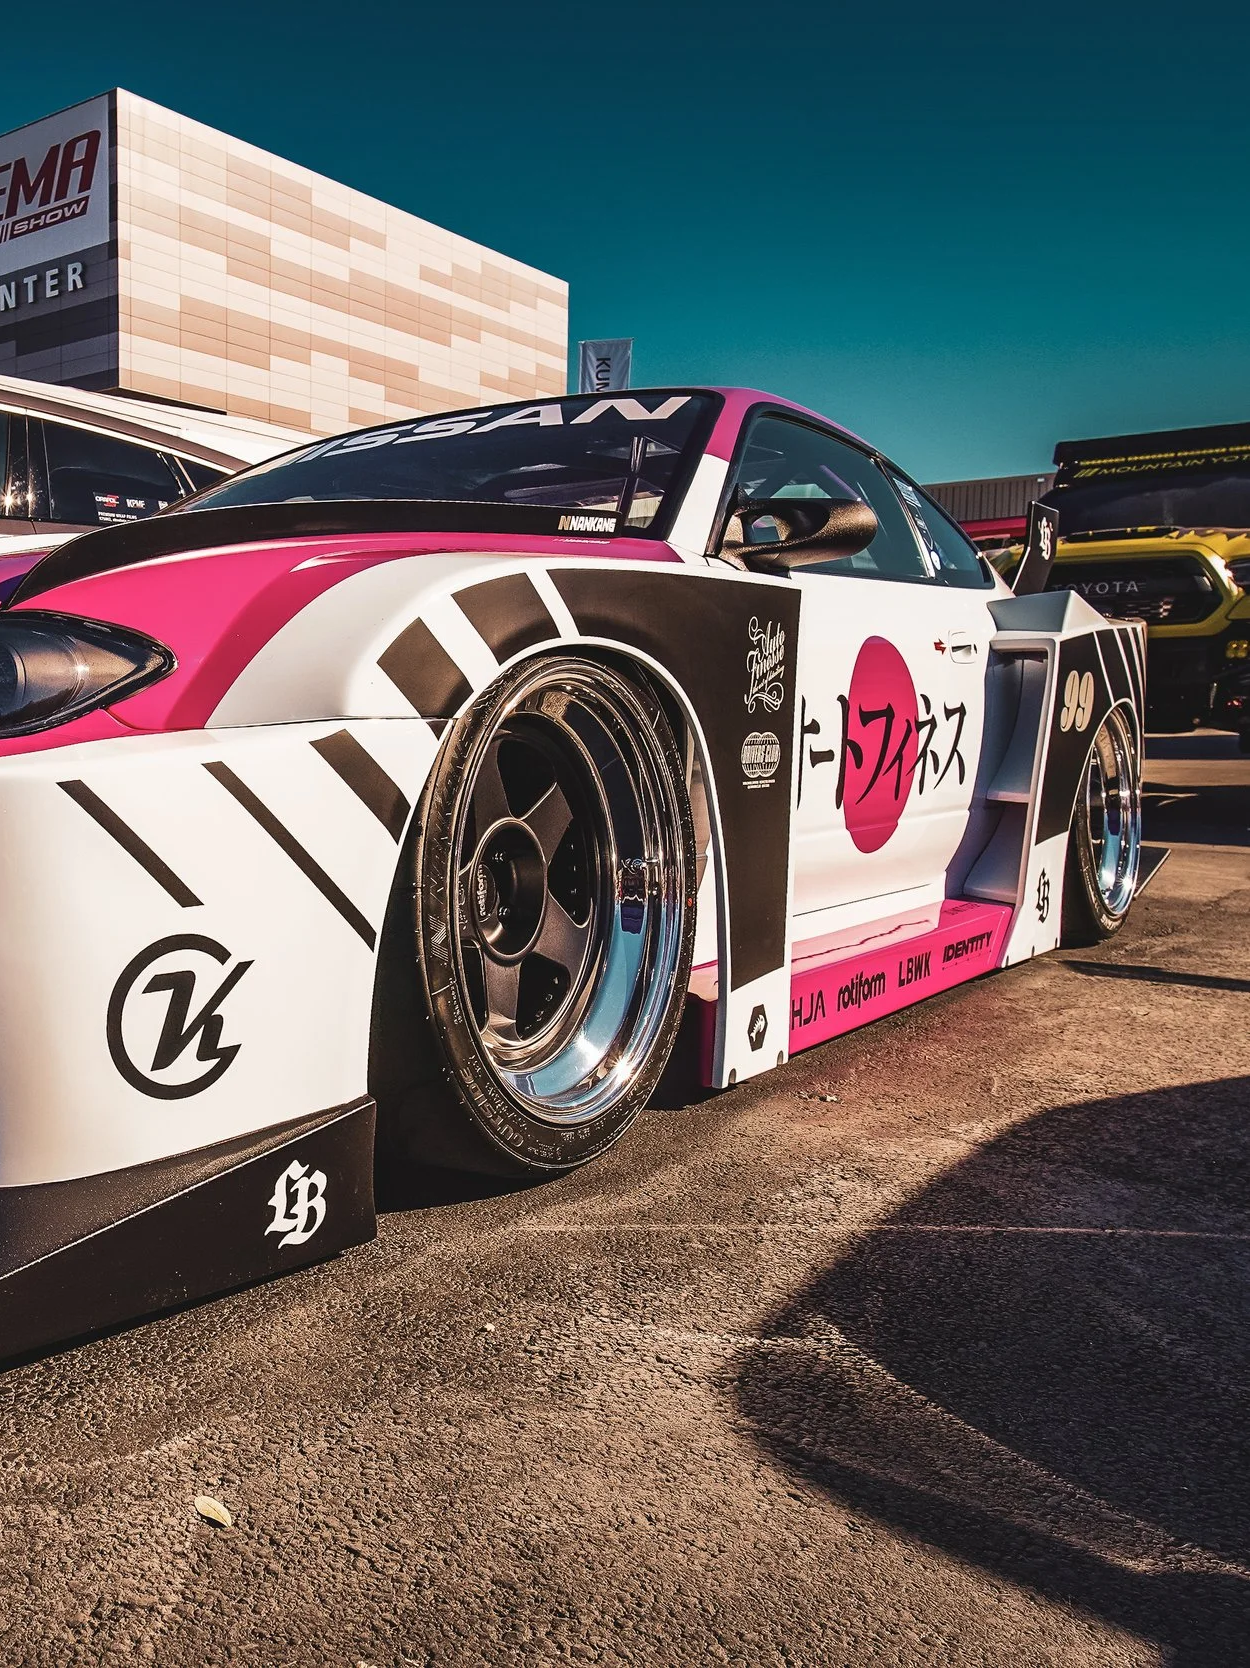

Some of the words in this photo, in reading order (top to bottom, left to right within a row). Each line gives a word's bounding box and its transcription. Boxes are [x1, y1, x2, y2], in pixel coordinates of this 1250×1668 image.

[13, 200, 86, 235] SHOW
[1097, 459, 1206, 476] MOUNTAIN
[570, 515, 617, 533] NANKANG
[749, 615, 786, 657] Auto
[1060, 669, 1095, 733] 99
[837, 970, 886, 1012] rotiform
[898, 950, 932, 988] LBWK
[942, 930, 993, 964] IDENTITY
[458, 1065, 526, 1148] OUTSIDE
